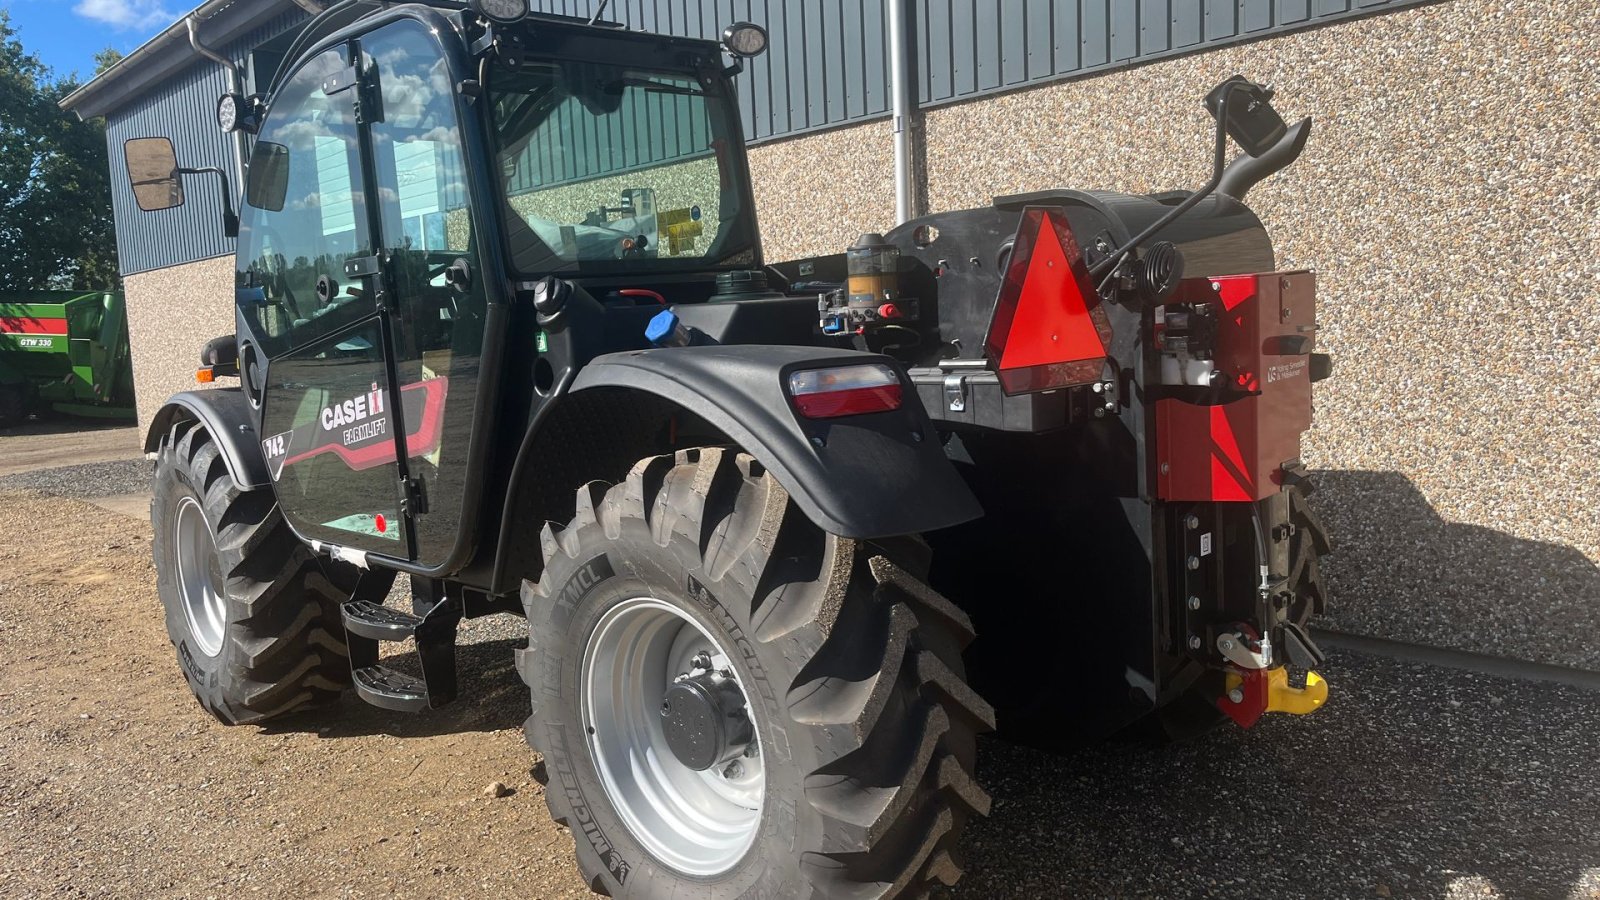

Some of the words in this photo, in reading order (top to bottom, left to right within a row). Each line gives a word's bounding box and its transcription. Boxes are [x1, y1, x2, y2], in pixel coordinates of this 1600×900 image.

[20, 338, 38, 347] GTW
[38, 339, 52, 348] 330
[321, 394, 367, 431] CASE
[265, 435, 285, 460] 742
[558, 564, 601, 616] XMCL
